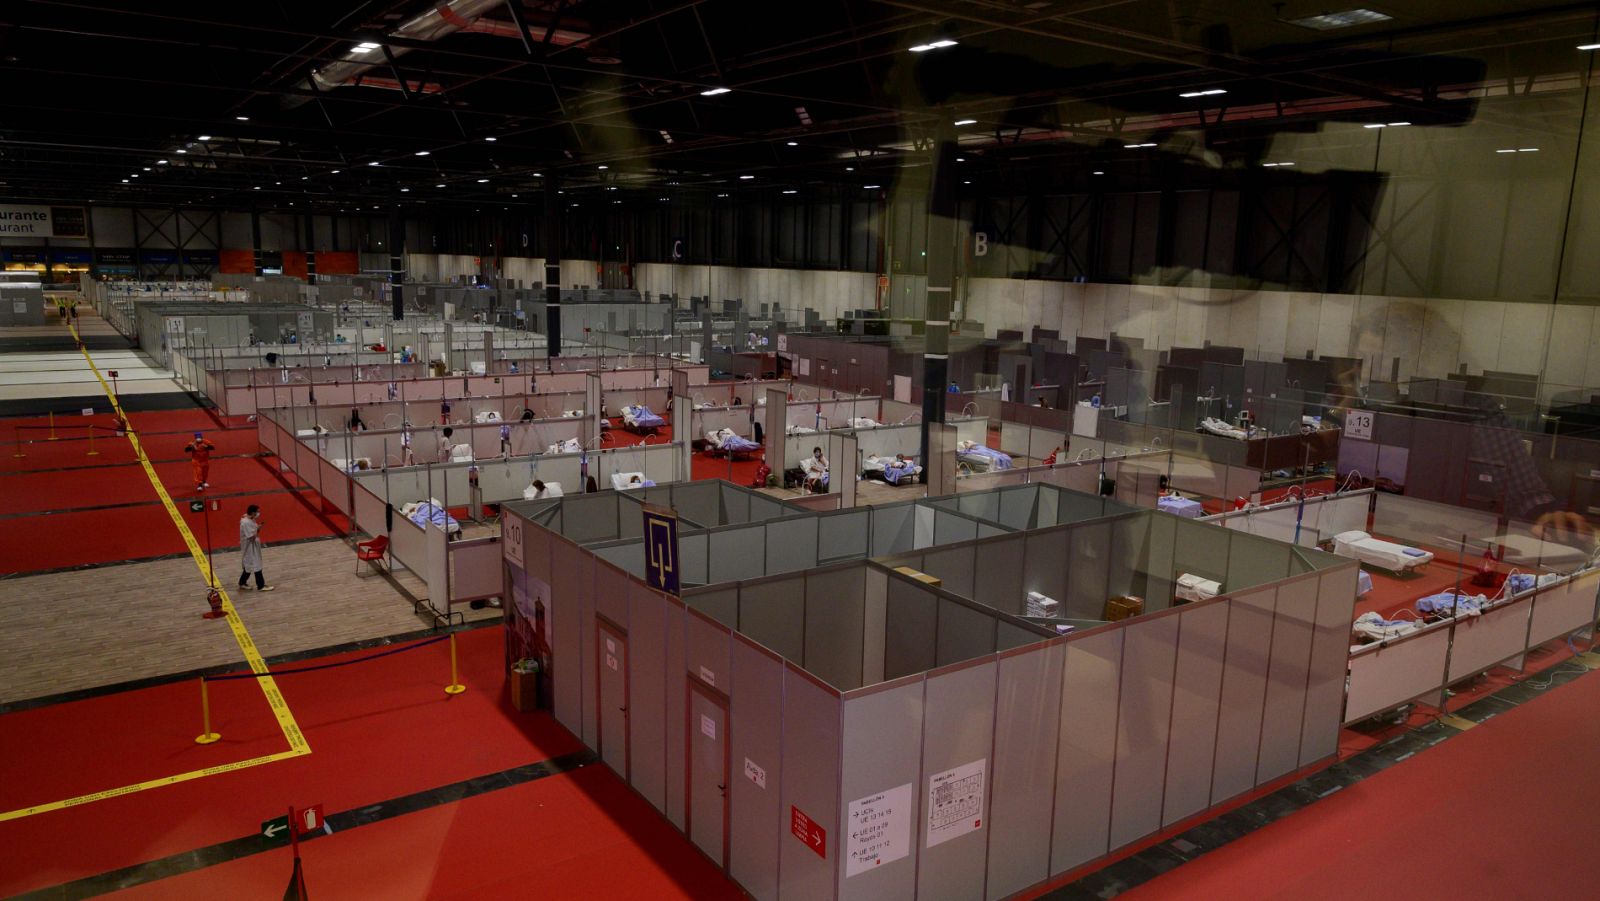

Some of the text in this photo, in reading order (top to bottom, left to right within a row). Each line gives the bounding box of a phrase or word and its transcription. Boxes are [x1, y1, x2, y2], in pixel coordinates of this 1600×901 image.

[674, 240, 682, 258] C
[975, 231, 988, 257] B
[859, 848, 868, 856] UE
